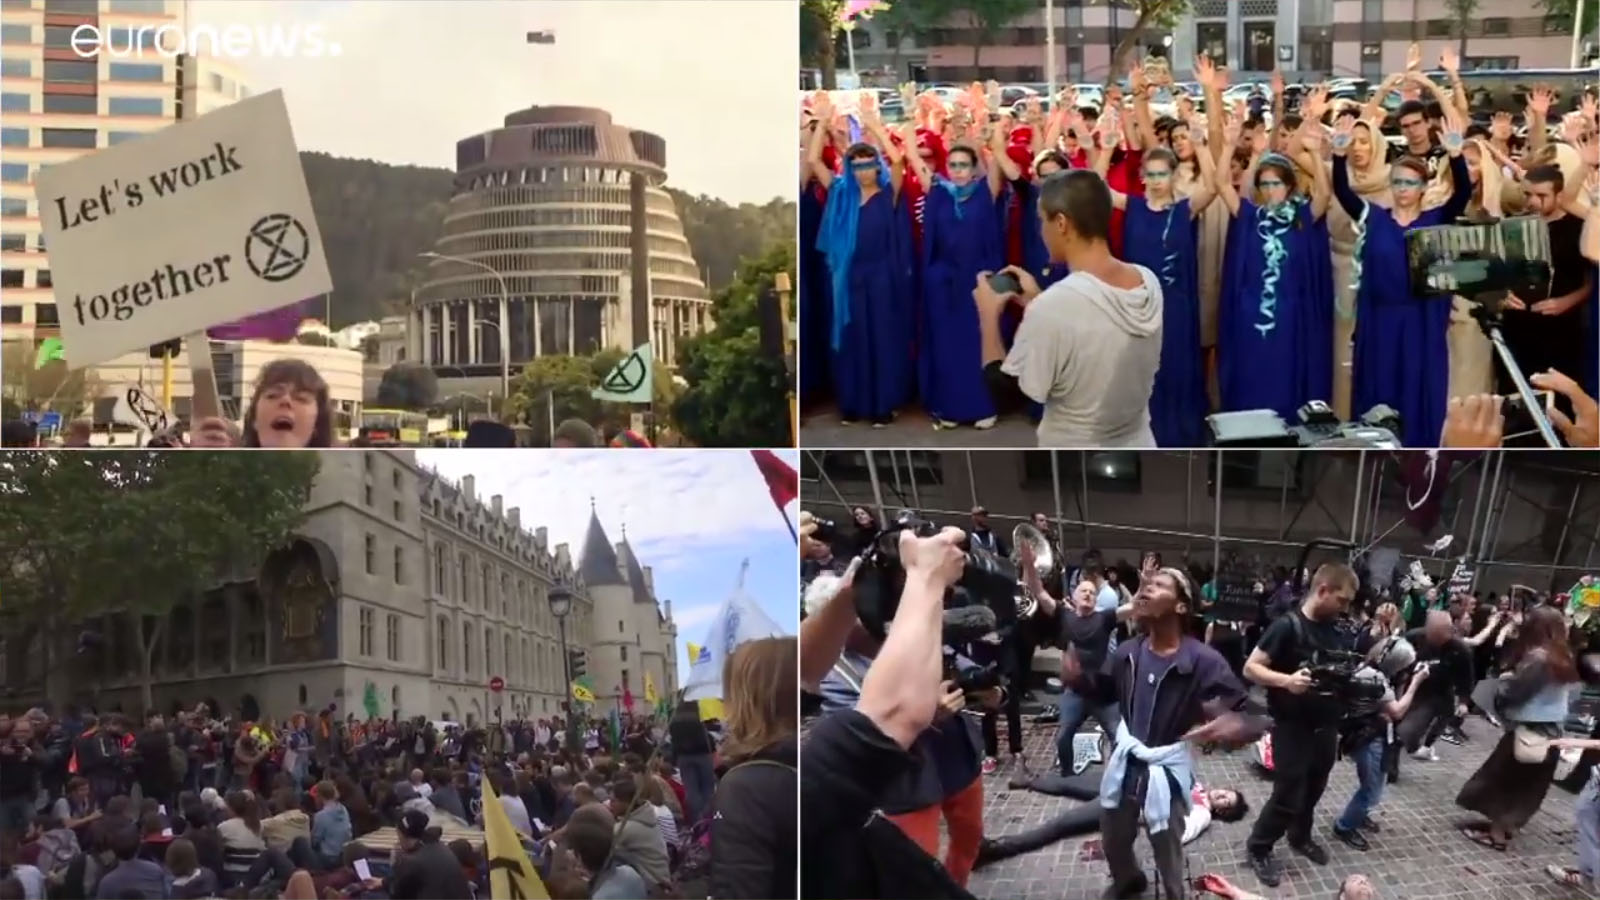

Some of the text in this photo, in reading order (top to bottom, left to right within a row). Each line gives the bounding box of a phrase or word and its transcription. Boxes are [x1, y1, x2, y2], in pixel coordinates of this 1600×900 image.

[55, 142, 243, 231] Let's work
[74, 252, 233, 326] together
